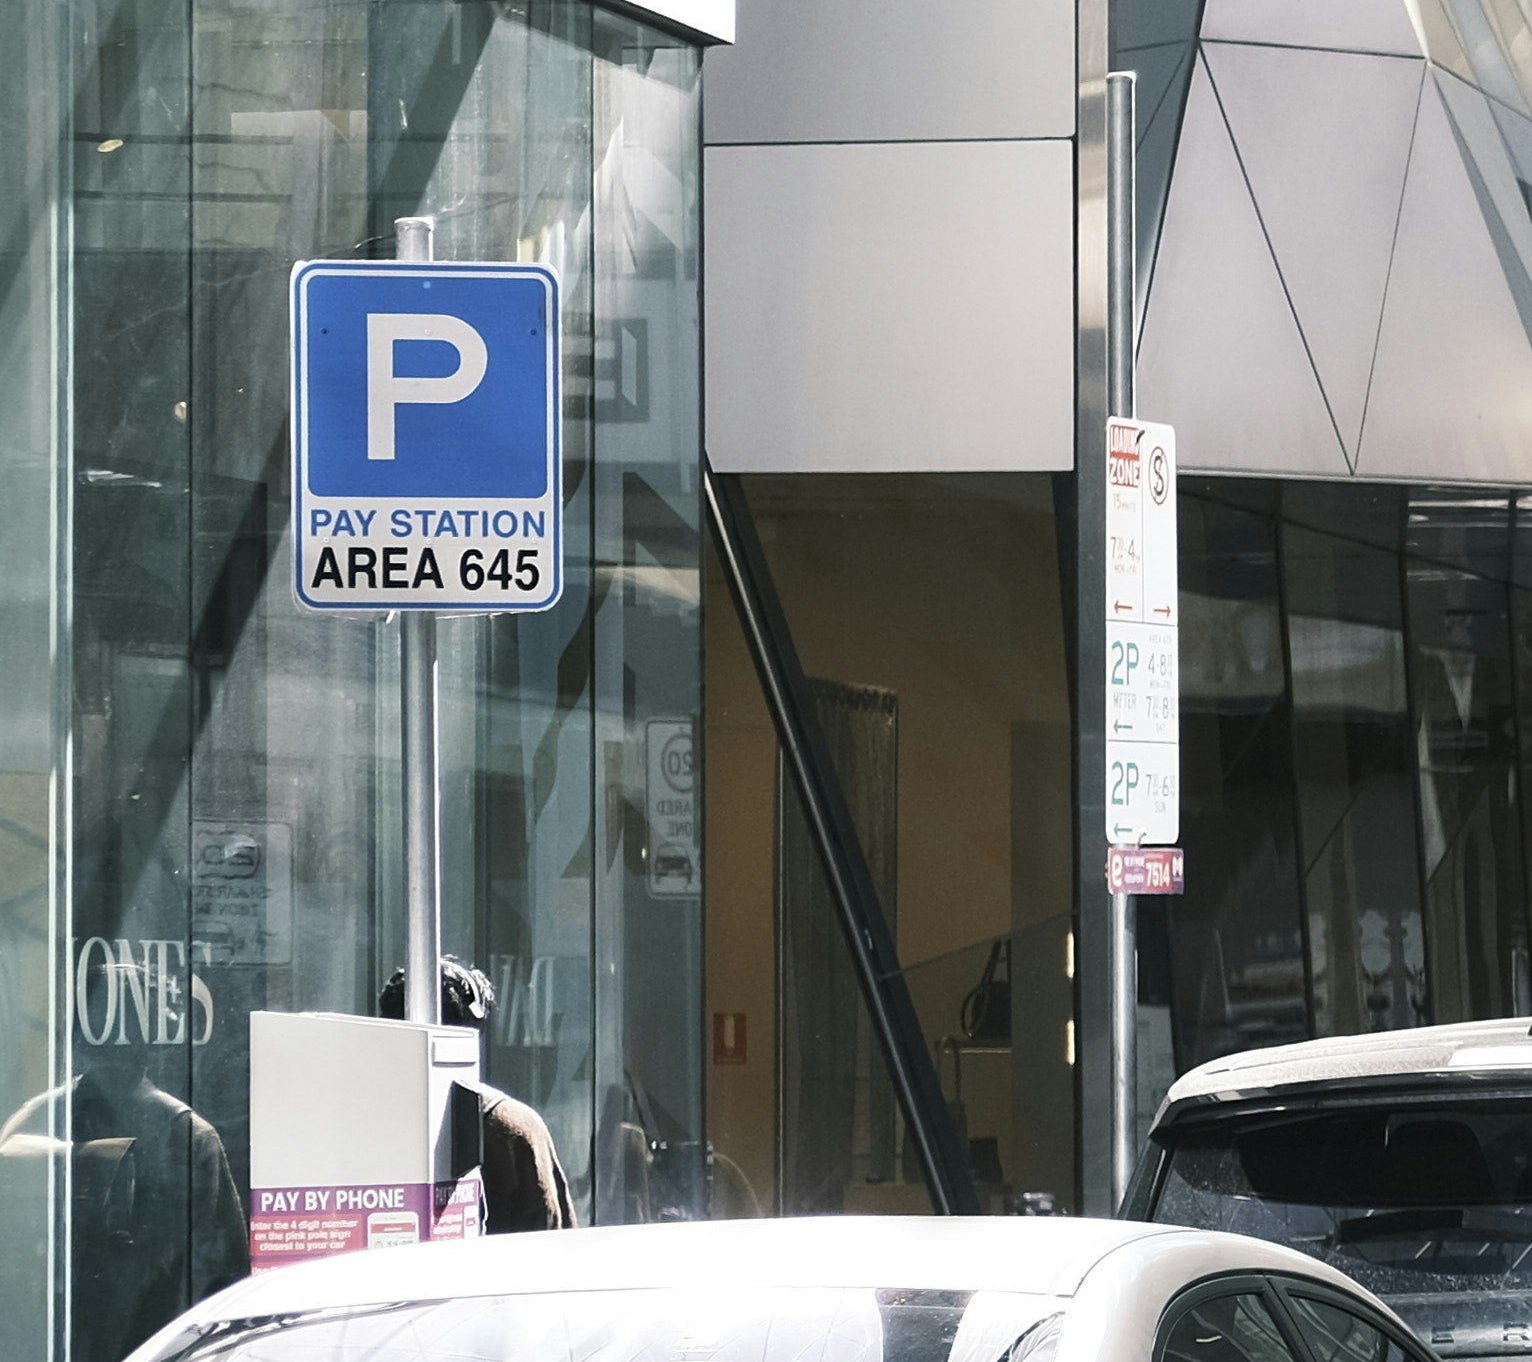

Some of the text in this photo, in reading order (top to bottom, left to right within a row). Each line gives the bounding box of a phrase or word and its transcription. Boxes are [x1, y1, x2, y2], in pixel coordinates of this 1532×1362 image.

[367, 313, 488, 460] P
[1110, 458, 1140, 487] ZONE
[310, 509, 546, 538] PAY STATION
[311, 547, 541, 591] AREA 645
[1111, 640, 1140, 687] 2P
[1111, 760, 1140, 807] 2P
[1145, 861, 1170, 887] 7514
[261, 1188, 405, 1213] PAY BY PHONE
